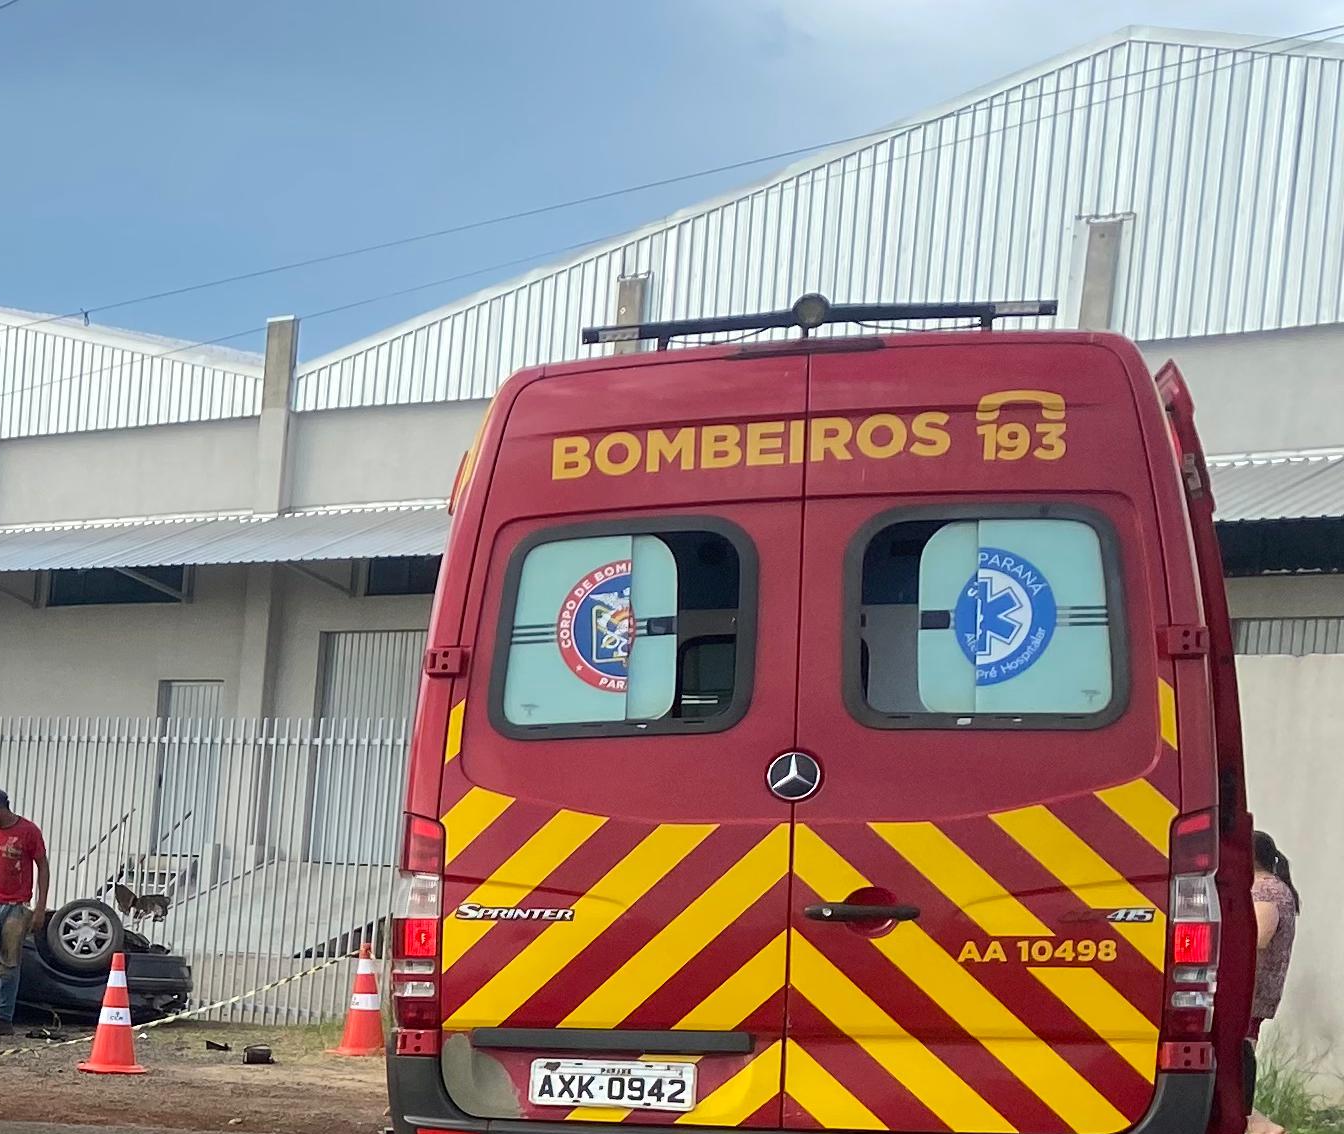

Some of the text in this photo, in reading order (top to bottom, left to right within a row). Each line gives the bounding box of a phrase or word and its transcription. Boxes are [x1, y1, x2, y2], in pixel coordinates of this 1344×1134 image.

[552, 412, 1067, 480] BOMBEIROS 193
[978, 552, 1048, 596] PARANÁ
[560, 600, 576, 648] CORPO
[575, 580, 593, 597] DE
[1001, 627, 1047, 674] Hospitalar
[1106, 908, 1155, 922] 415
[957, 940, 1118, 963] AA 10498
